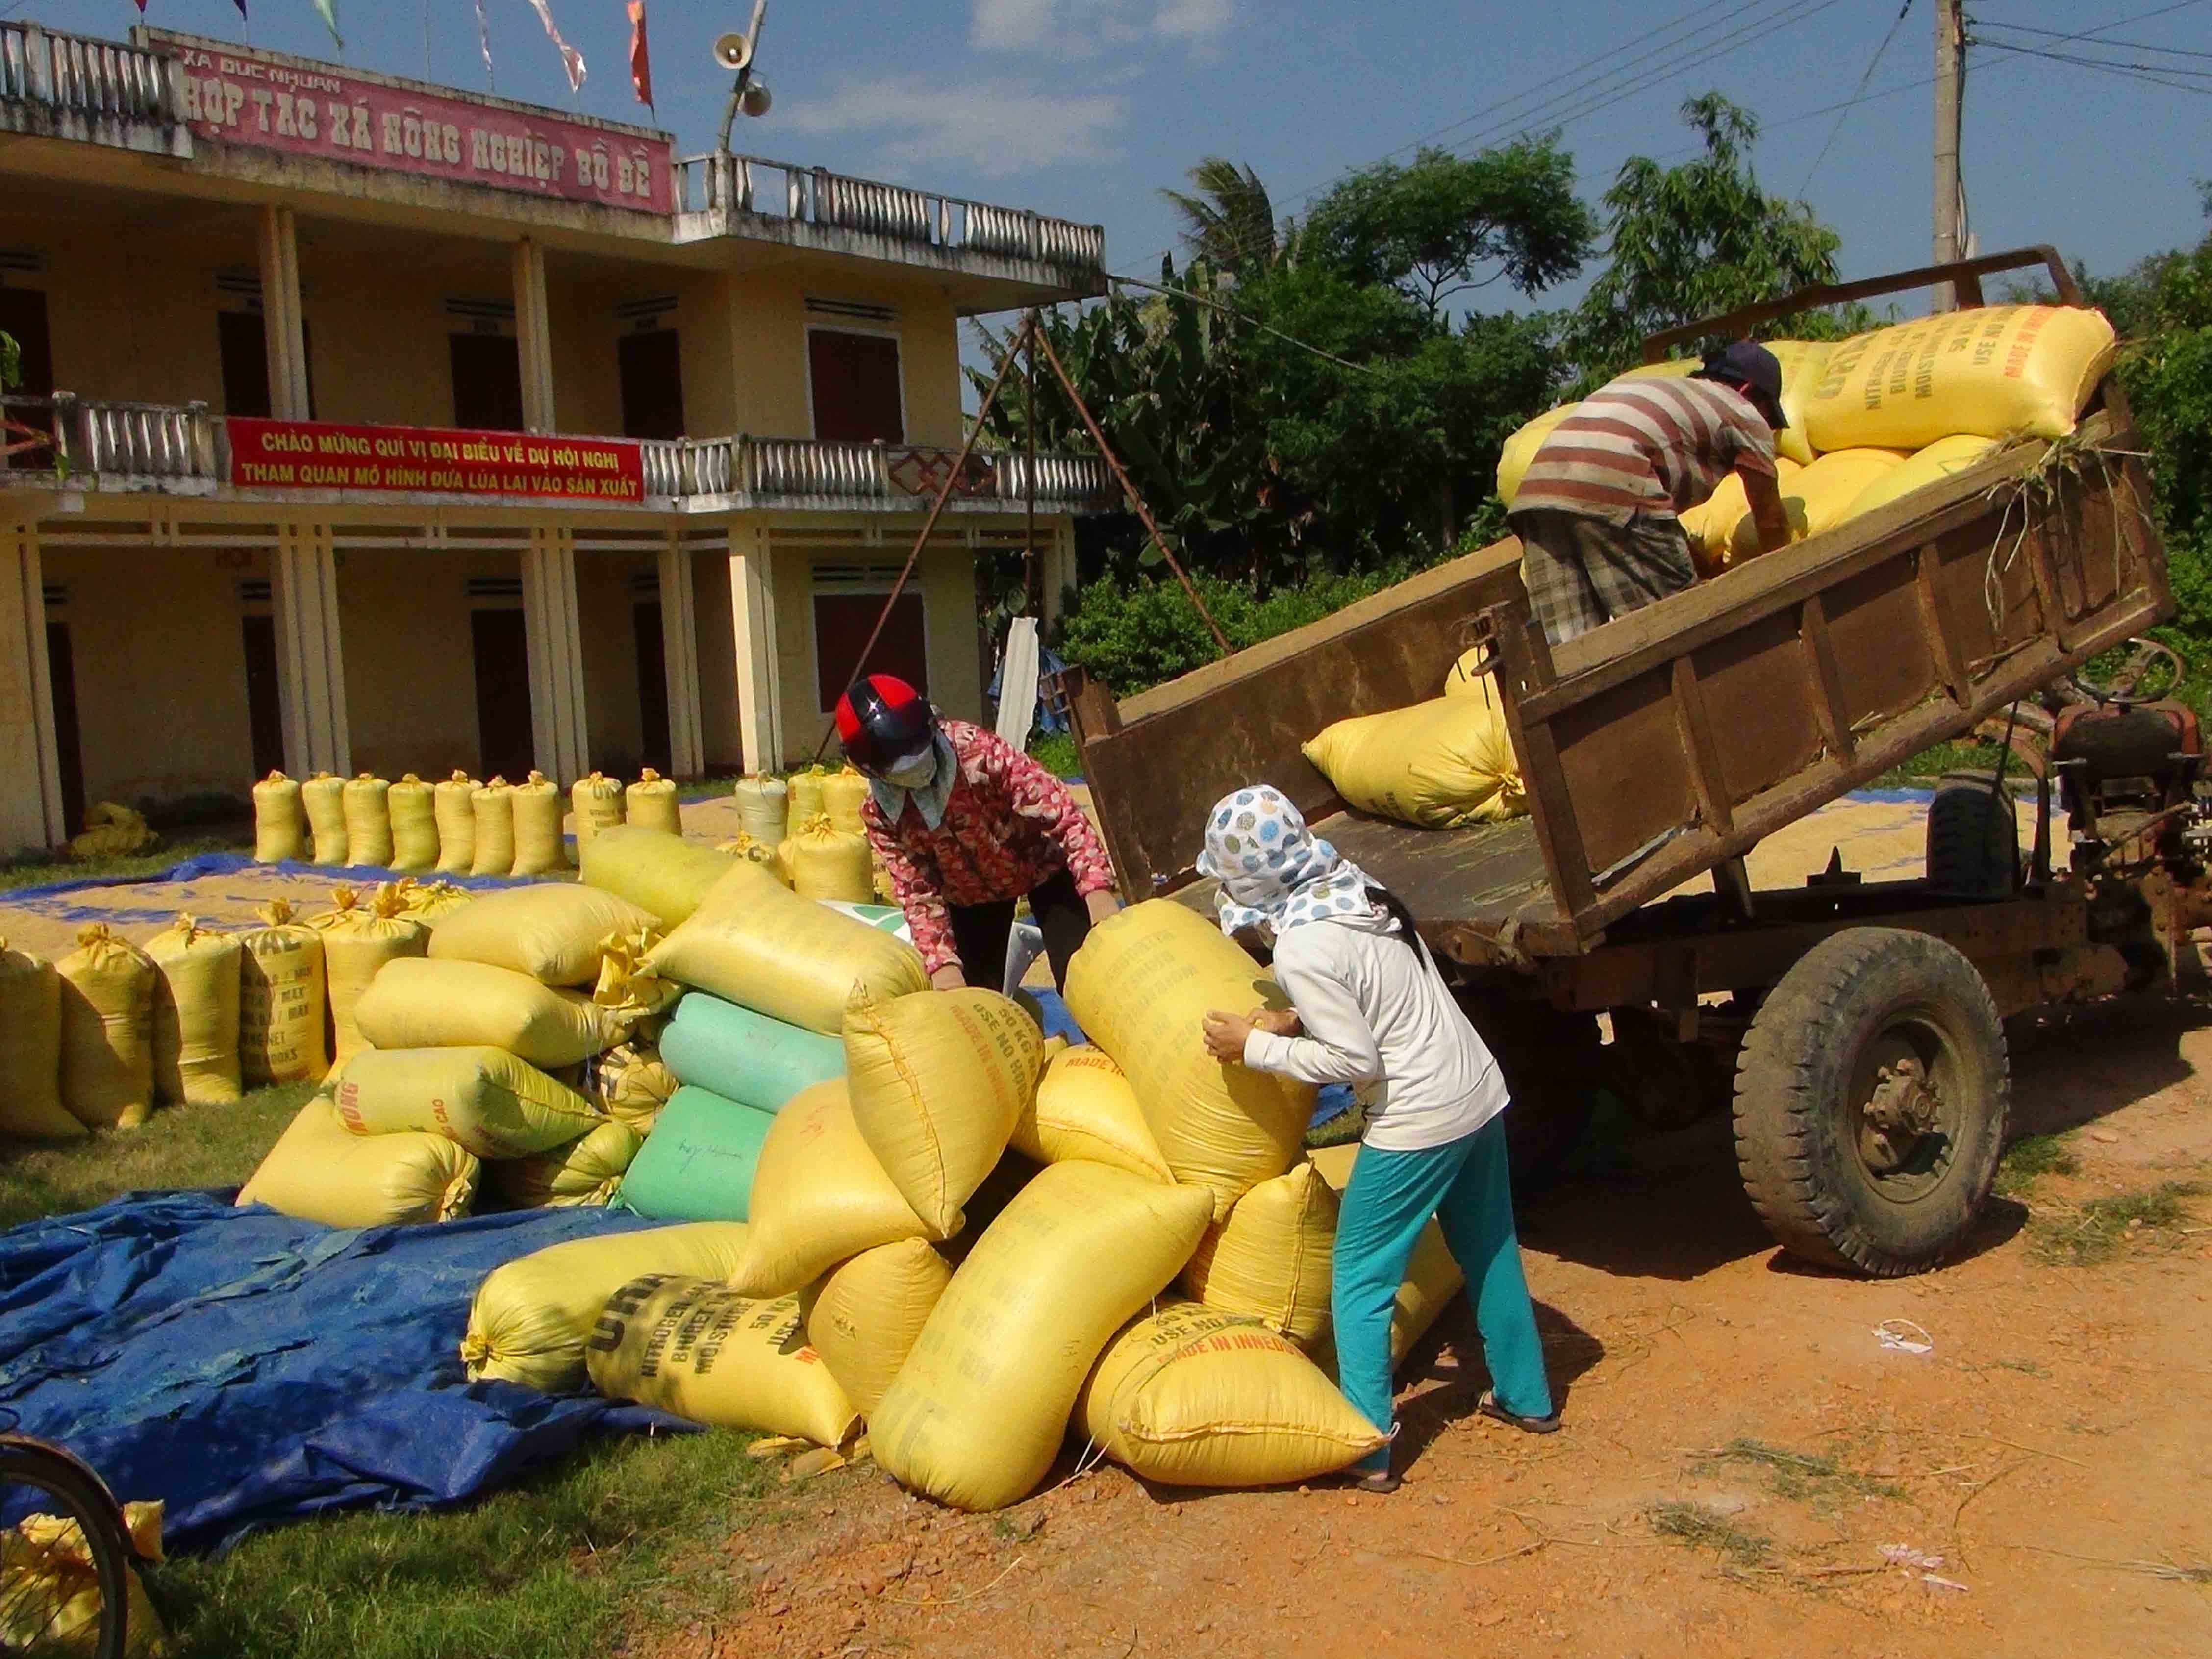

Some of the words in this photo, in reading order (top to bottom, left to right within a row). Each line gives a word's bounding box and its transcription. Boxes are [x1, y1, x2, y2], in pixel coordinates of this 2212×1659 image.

[382, 106, 461, 165] NÔNG
[470, 127, 564, 188] NGHIỆP
[1973, 341, 1996, 366] USE
[261, 428, 314, 453] CHÀO
[318, 431, 371, 455] MỪNG
[376, 435, 405, 457] QUÍ
[410, 440, 427, 462] VỊ
[431, 442, 459, 465] ĐẠI
[462, 436, 500, 462] BIỂU
[503, 439, 525, 463] VỀ
[528, 446, 549, 469] DỰ
[553, 446, 579, 471] HỘI
[582, 450, 619, 473] NGHỊ
[242, 462, 294, 481] THAM
[299, 464, 349, 484] QUAN
[354, 464, 380, 485] MÔ
[385, 465, 427, 486] HÌNH
[431, 468, 463, 488] ĐƯA
[468, 468, 498, 490] LÚA
[503, 473, 527, 491] LAI
[531, 472, 562, 492] VÀO
[566, 472, 596, 494] SẢN
[600, 474, 637, 496] XUẤT
[972, 1003, 1001, 1032] USE
[996, 1031, 1015, 1059] NO
[1014, 1028, 1032, 1054] KG
[1065, 1057, 1108, 1070] MADE
[640, 1299, 693, 1378] NITROGEN
[670, 1308, 716, 1363] BIURET
[694, 1300, 756, 1375] MOISTURE
[749, 1314, 779, 1330] 50
[1150, 1323, 1189, 1345] USE
[1209, 1335, 1232, 1352] IN
